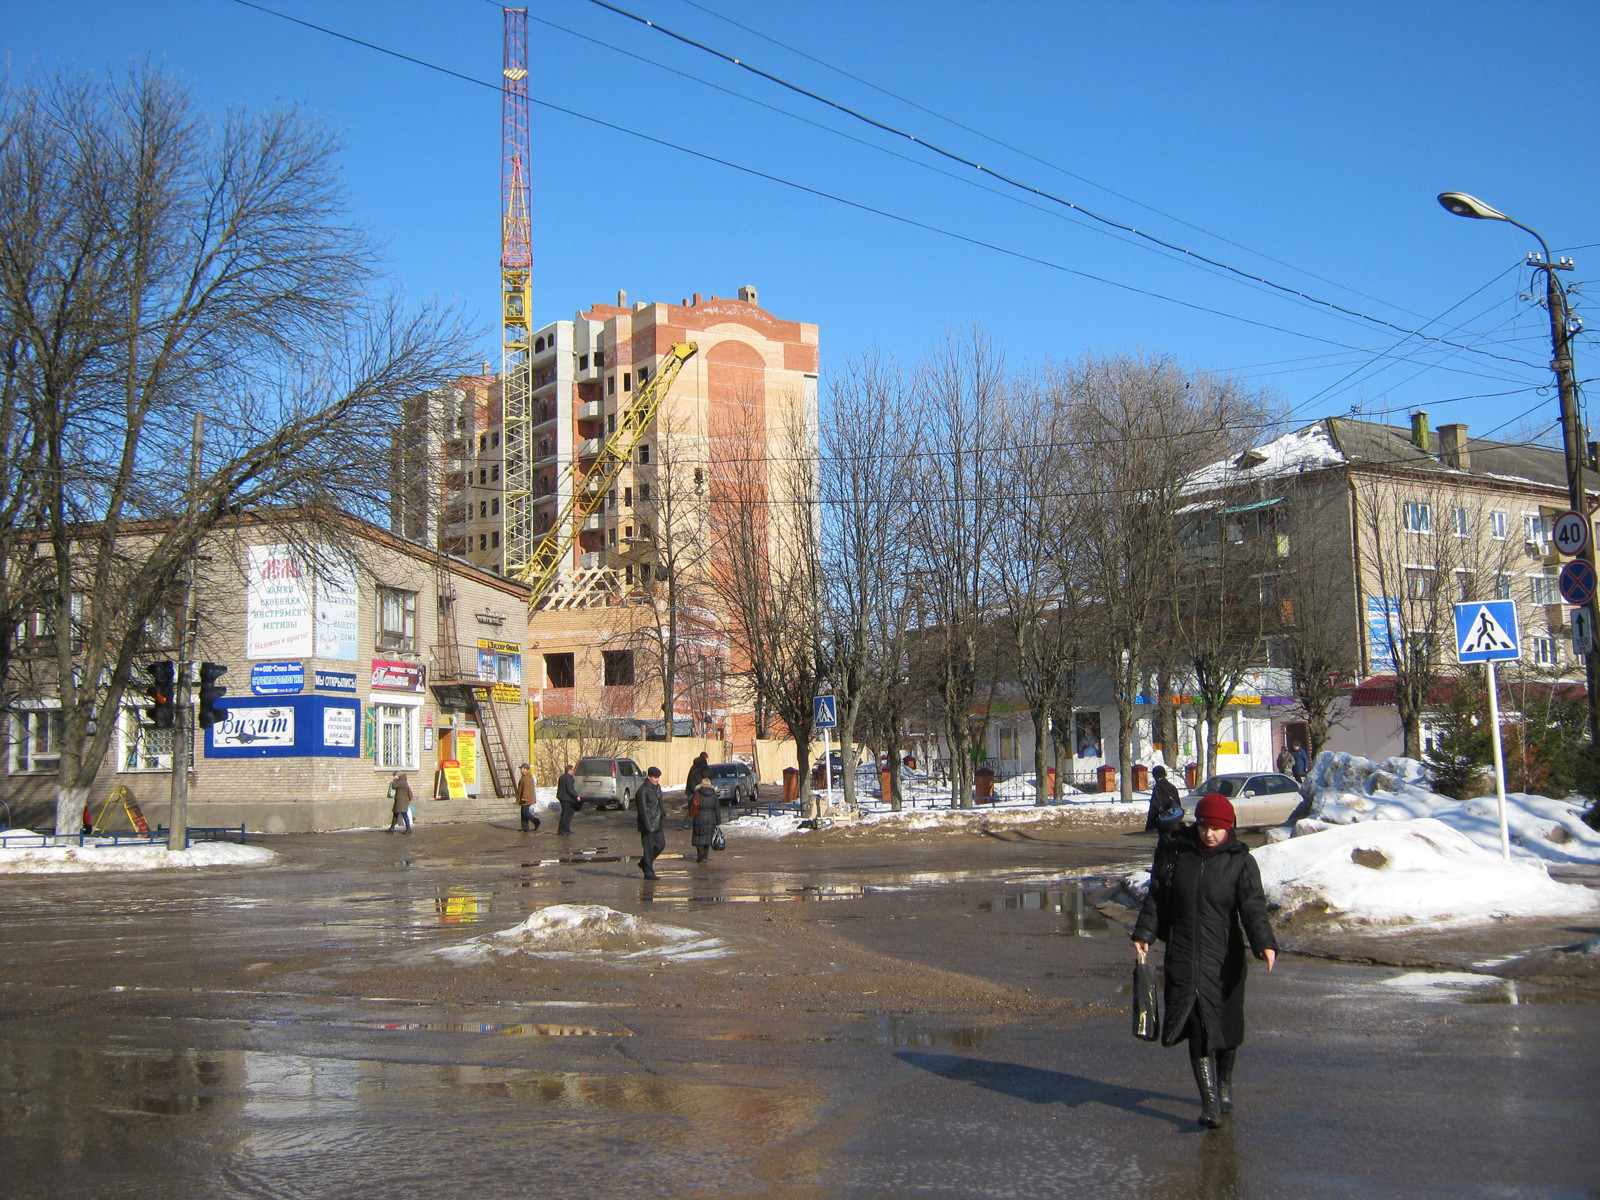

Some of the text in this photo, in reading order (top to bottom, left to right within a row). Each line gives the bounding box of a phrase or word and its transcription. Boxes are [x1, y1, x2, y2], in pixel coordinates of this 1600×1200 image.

[1559, 523, 1580, 544] 40
[267, 586, 294, 594] ЗАМКИ
[260, 597, 301, 606] СКОБЯНКА
[253, 608, 308, 619] ИНСТРУМЕНТ
[344, 610, 356, 619] ДЛЯ
[263, 621, 297, 630] МЕТИЗЫ
[333, 620, 356, 630] ВАШЕГО
[340, 633, 356, 642] ДОМА
[252, 674, 303, 685] СТОМАТОЛОГИЯ
[315, 675, 324, 686] МЫ
[217, 711, 288, 736] Визит
